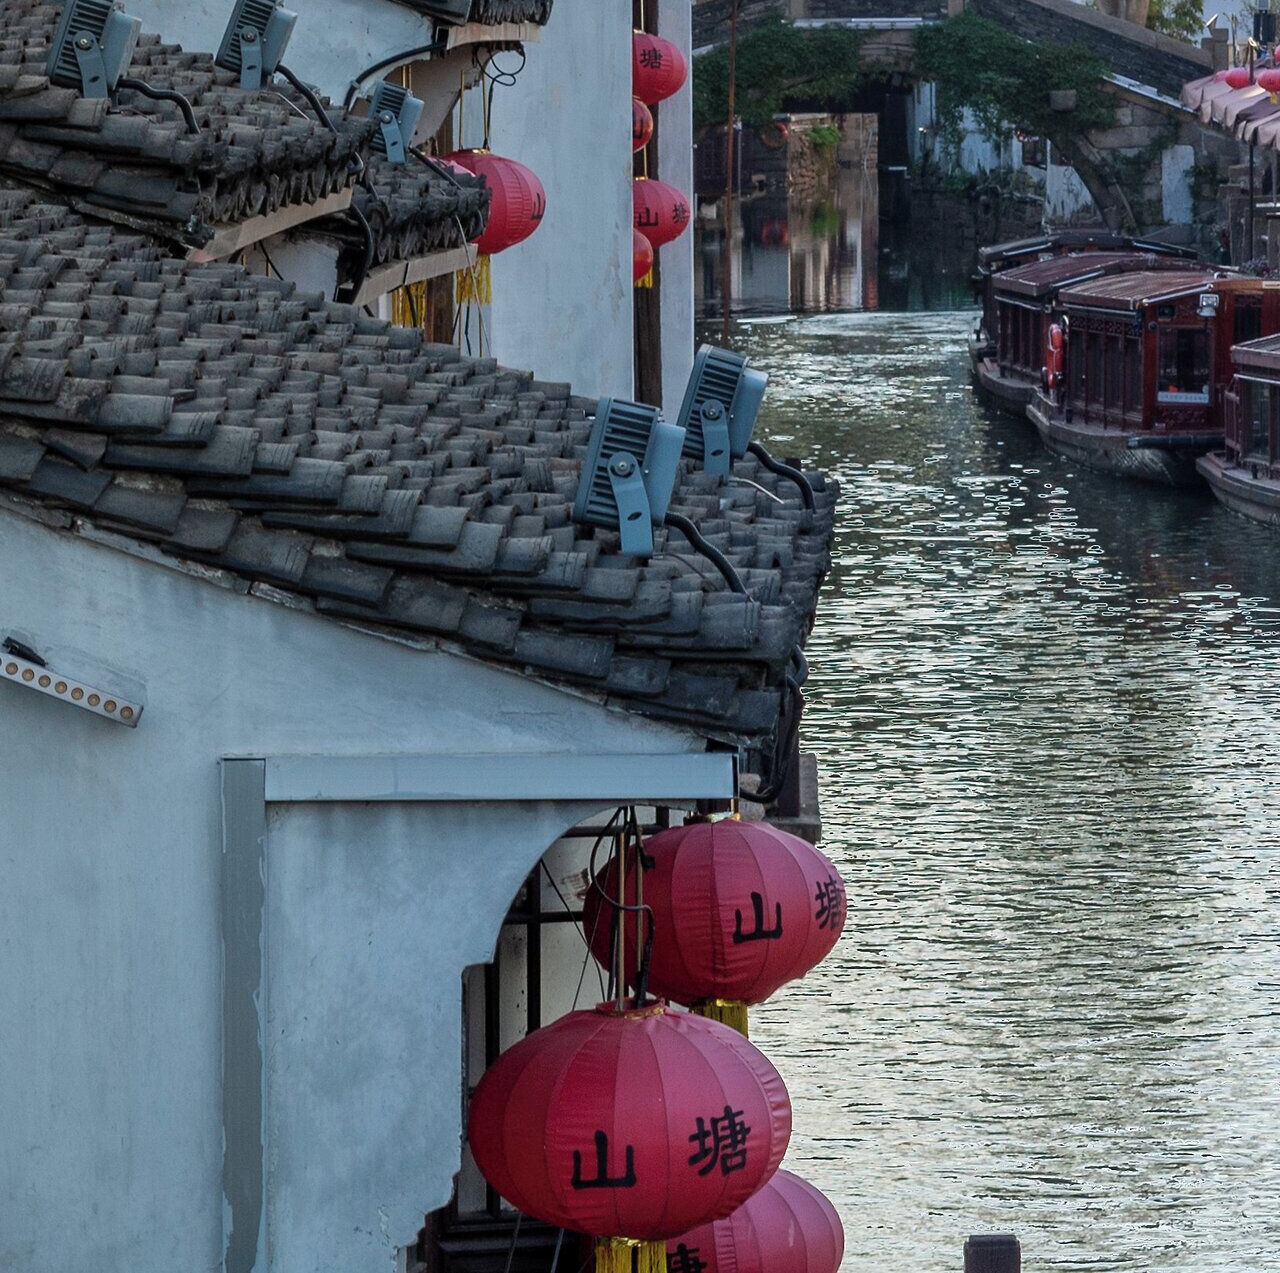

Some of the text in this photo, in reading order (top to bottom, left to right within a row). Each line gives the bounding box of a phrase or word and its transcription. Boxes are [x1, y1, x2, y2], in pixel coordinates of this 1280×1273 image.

[639, 47, 664, 70] 塘
[638, 202, 689, 228] 山塘
[733, 875, 843, 945] 山塘
[571, 1104, 752, 1190] 山塘
